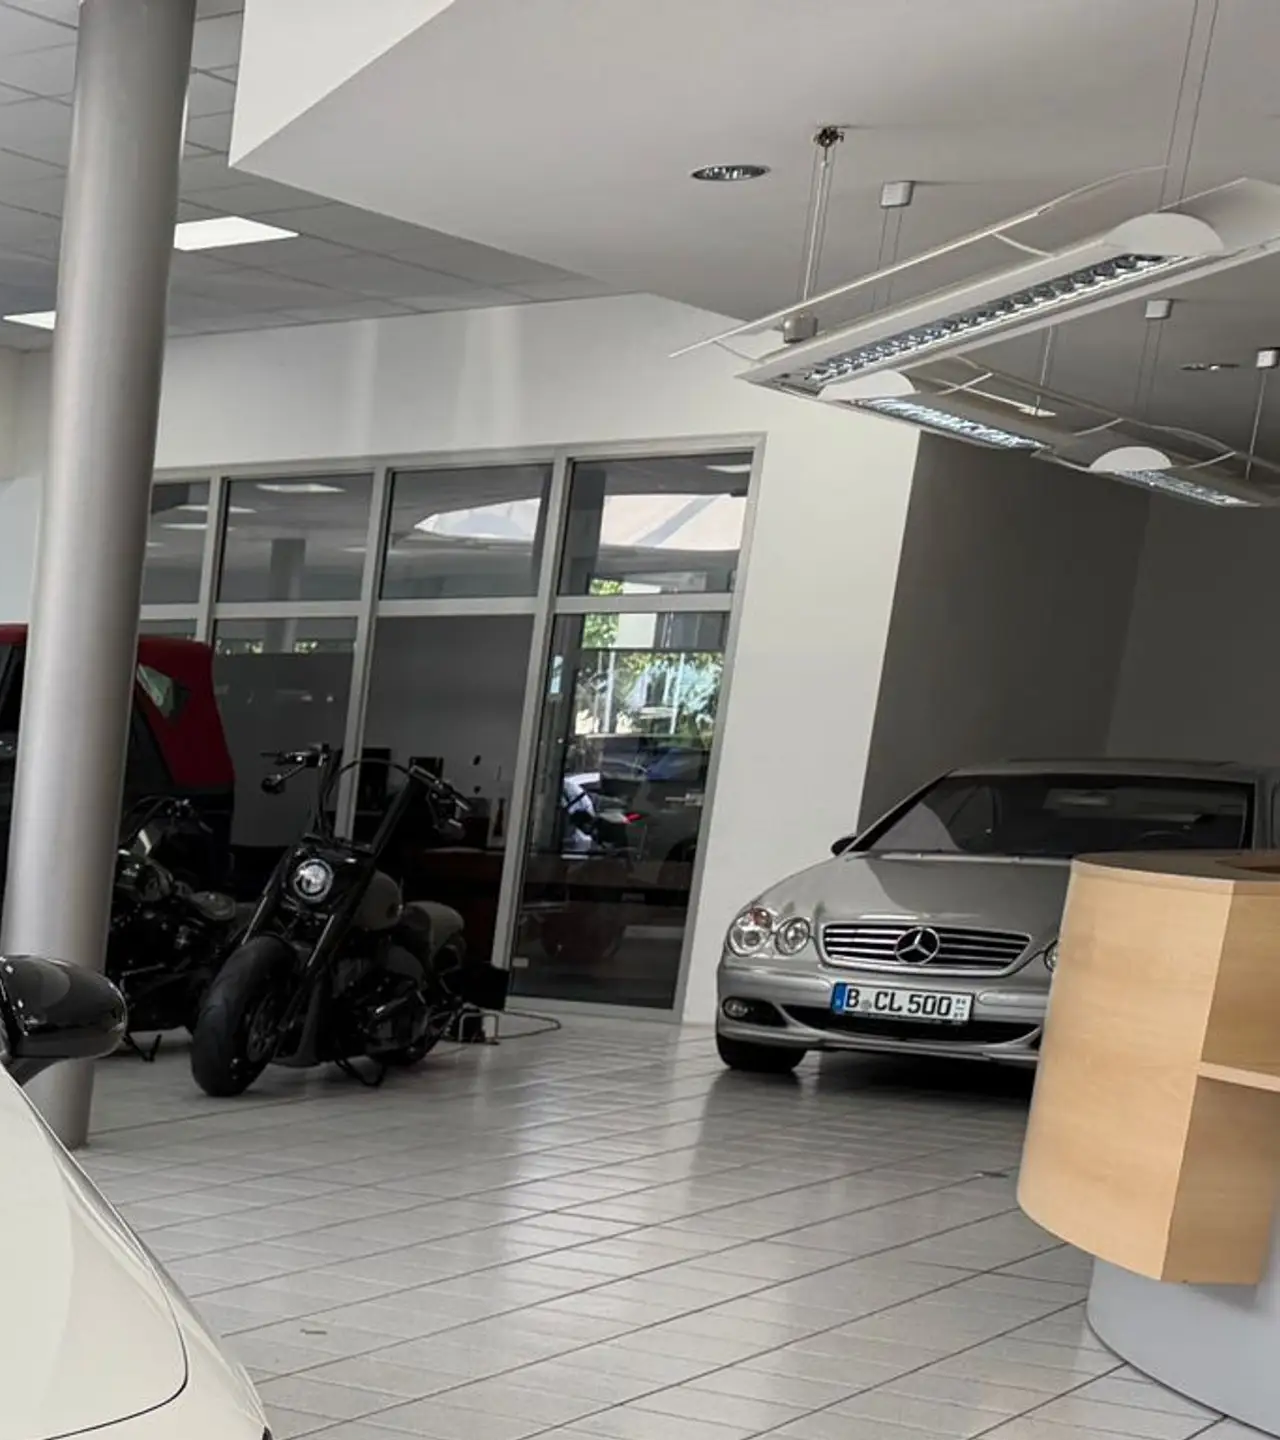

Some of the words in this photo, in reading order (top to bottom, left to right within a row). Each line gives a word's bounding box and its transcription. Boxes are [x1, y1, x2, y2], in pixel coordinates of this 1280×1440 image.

[845, 987, 860, 1009] B
[874, 991, 903, 1012] CL
[907, 993, 952, 1016] 500
